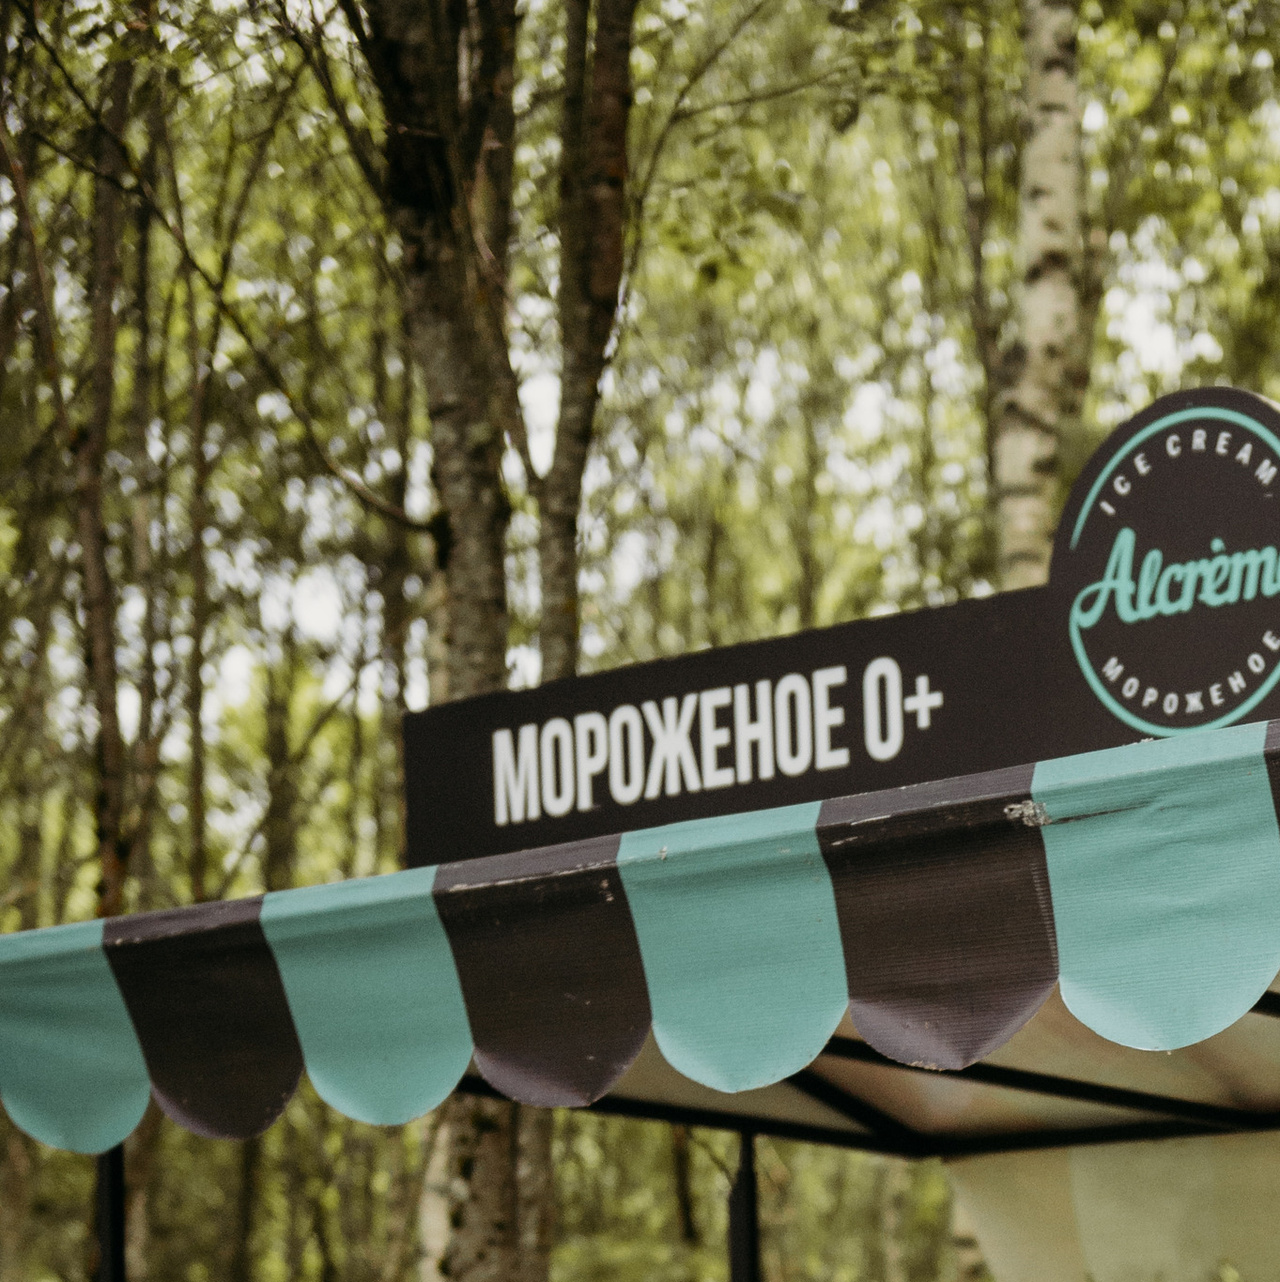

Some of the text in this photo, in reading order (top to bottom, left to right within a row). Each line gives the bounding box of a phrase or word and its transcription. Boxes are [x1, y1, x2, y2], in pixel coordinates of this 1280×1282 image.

[1099, 428, 1278, 516] ICE CREAM
[492, 657, 944, 826] МОРОЖЕНОЕ 0+
